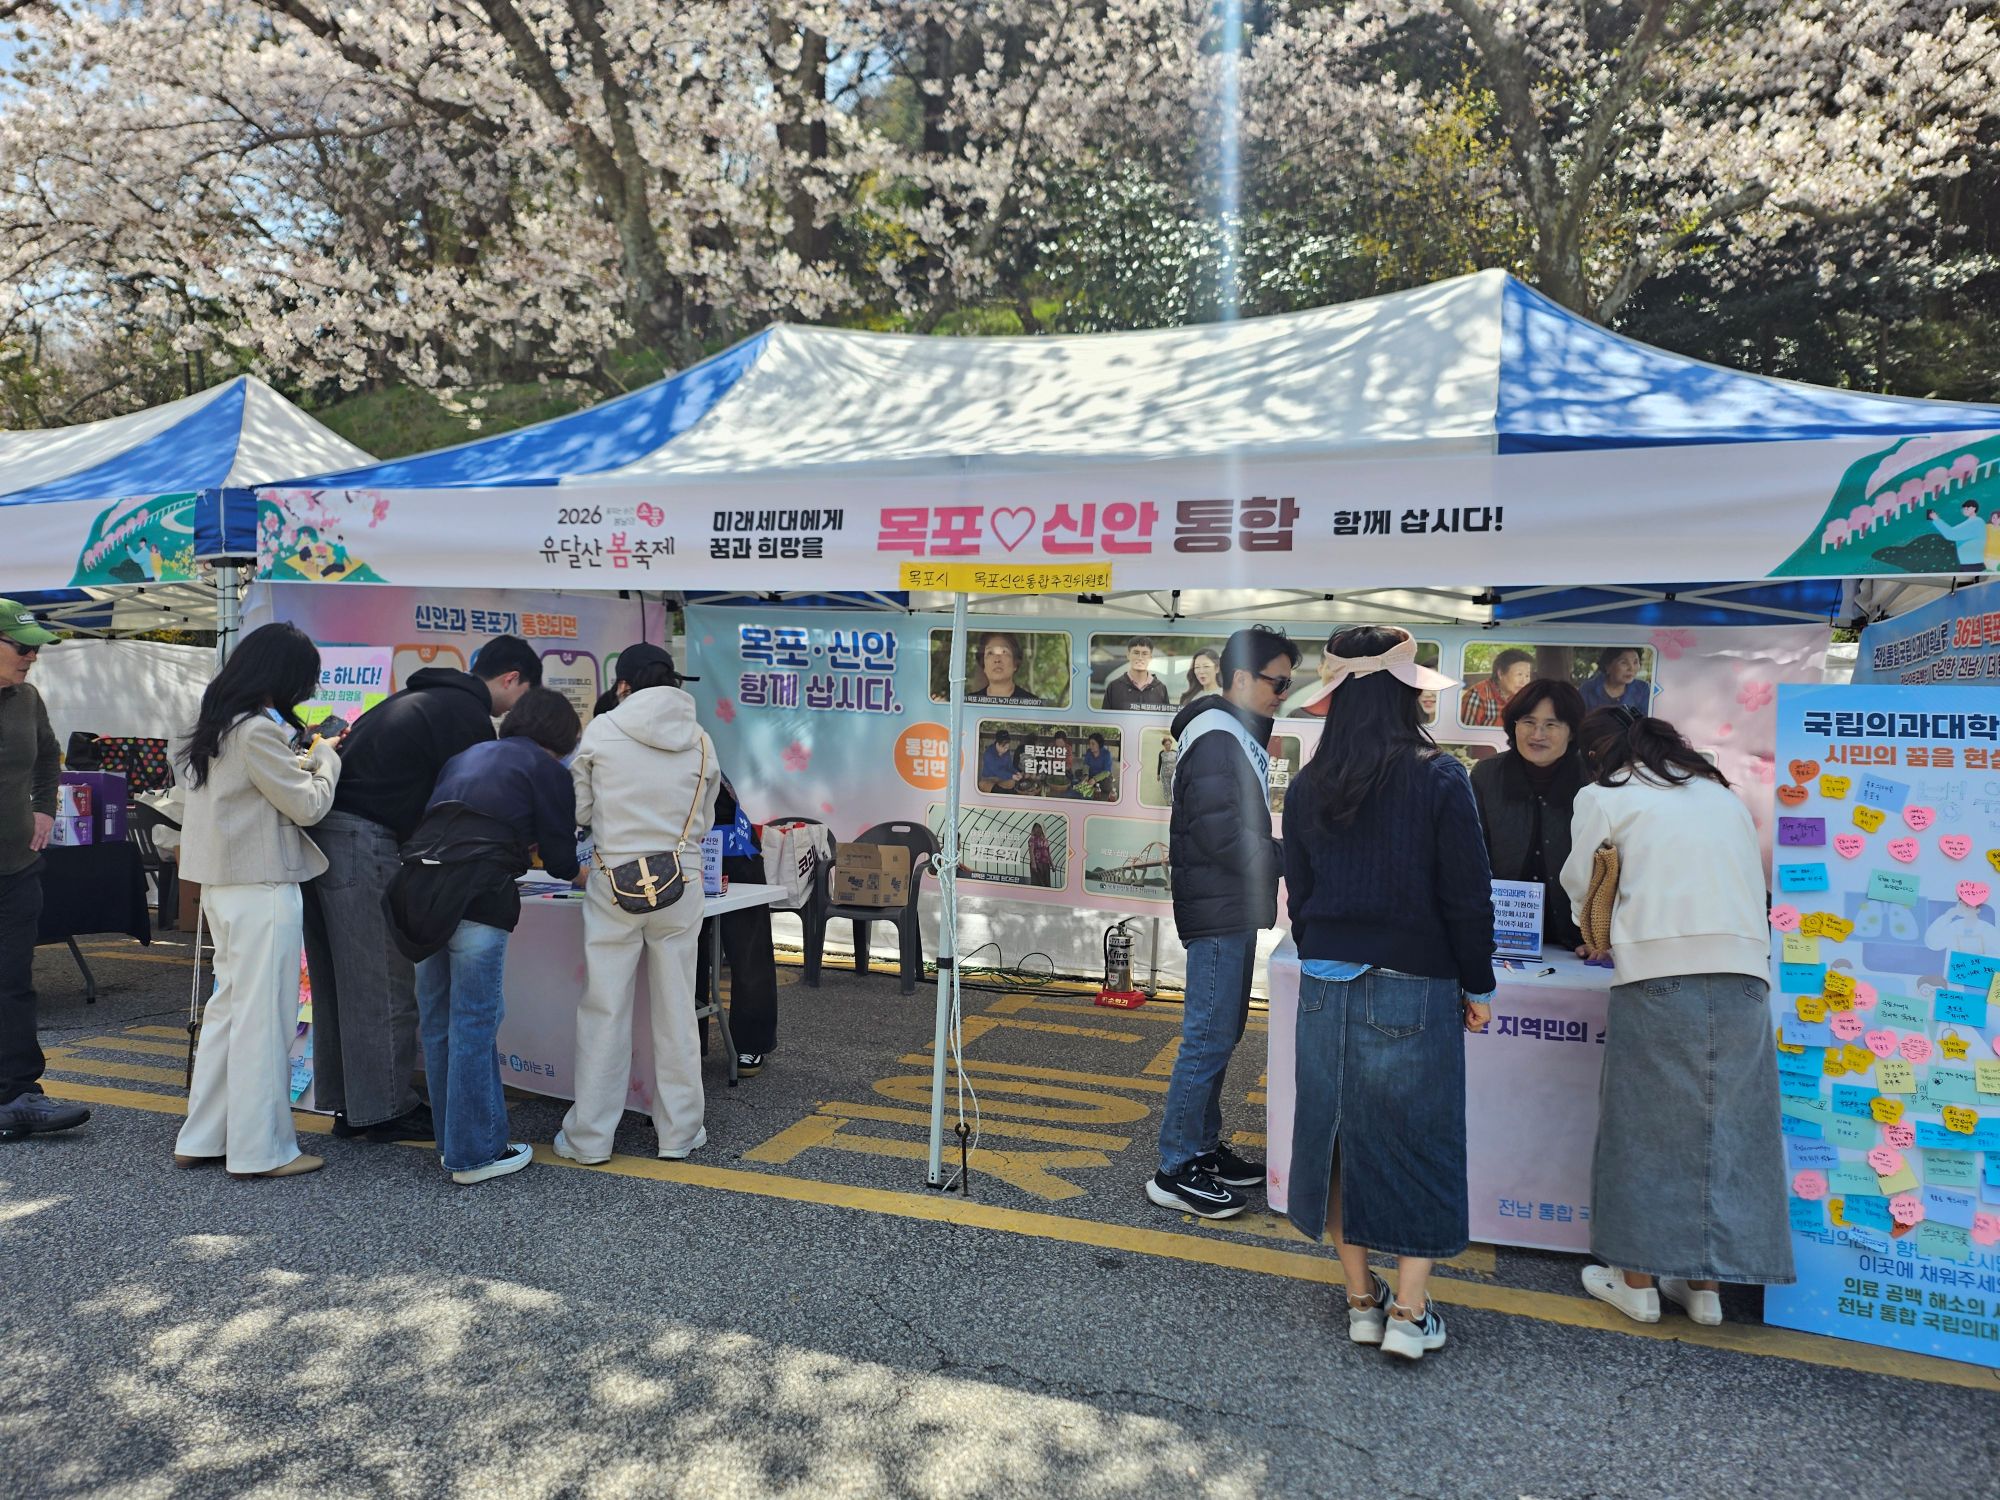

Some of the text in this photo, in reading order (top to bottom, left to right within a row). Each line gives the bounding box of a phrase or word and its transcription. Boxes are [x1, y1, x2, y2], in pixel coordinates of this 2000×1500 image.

[557, 505, 602, 524] 2026
[713, 509, 844, 532] 미래세대에게
[876, 497, 1300, 556] 목포 신안 통합
[1333, 506, 1503, 535] 함께 삽시다!
[539, 534, 603, 569] 유달산
[710, 536, 824, 560] 꿈과 희망을
[909, 570, 949, 587] 목포시
[415, 604, 578, 638] 신안과 목포가 통합되면
[1953, 617, 1982, 646] 36년
[334, 666, 383, 685] 하나다!
[740, 674, 903, 711] 함께 삽시다.
[1023, 744, 1068, 759] 목포신안
[1824, 745, 1896, 766] 시민의
[1906, 747, 1955, 768] 꿈을
[912, 759, 946, 777] 되면
[1023, 759, 1067, 775] 합치면
[1497, 1015, 1588, 1043] 지역민의
[544, 1062, 555, 1078] 길
[1498, 1199, 1534, 1219] 전남
[1539, 1202, 1574, 1222] 통합
[1859, 1255, 1913, 1280] 이곳에
[1844, 1277, 1985, 1317] 의료 공백 해소의
[1838, 1296, 2000, 1342] 전남 통합 국립의대
